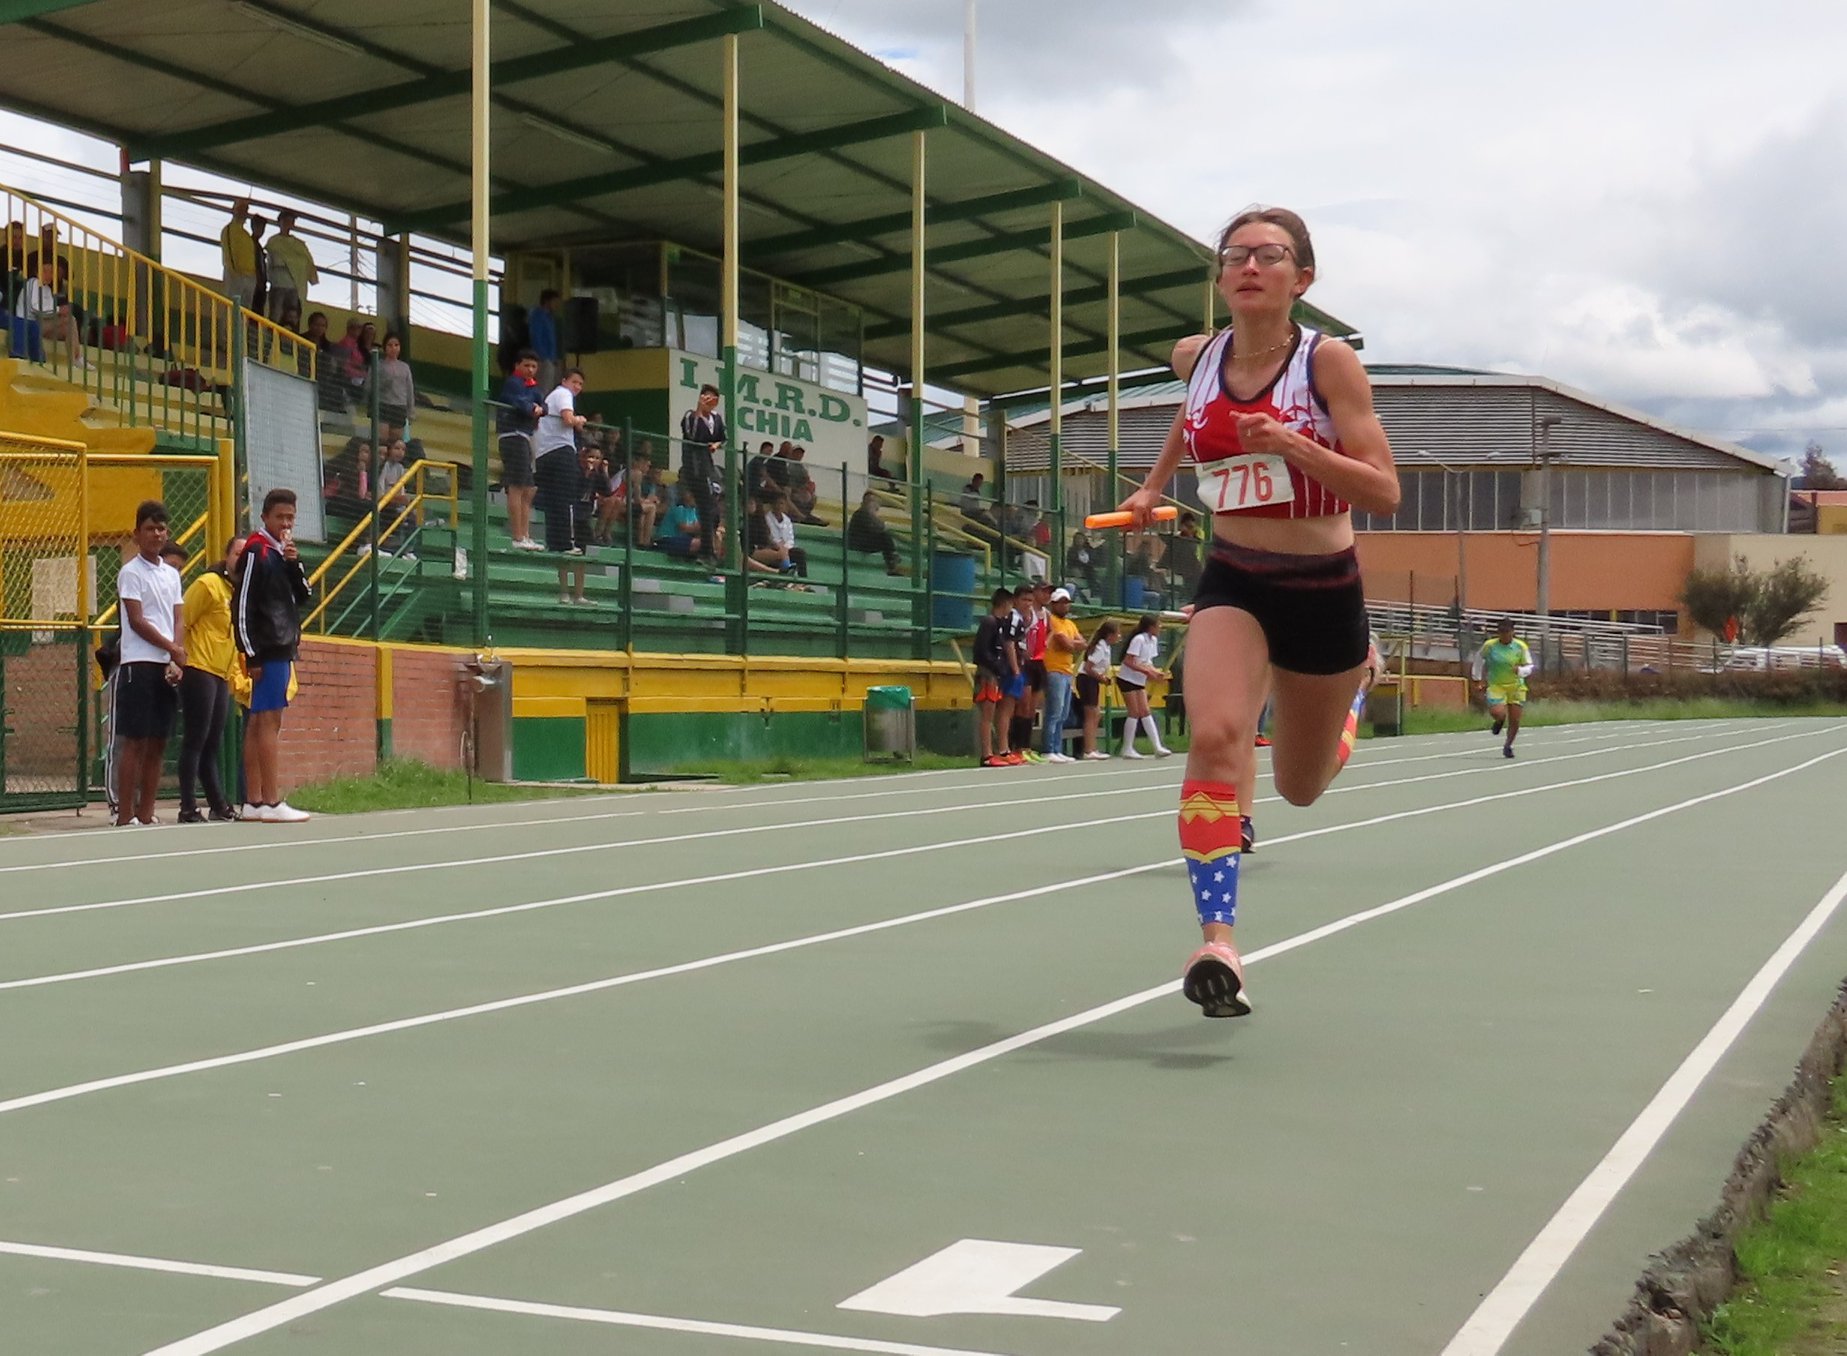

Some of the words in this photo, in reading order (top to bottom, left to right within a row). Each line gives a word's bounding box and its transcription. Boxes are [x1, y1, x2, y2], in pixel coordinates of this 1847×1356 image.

[679, 357, 862, 428] IM.R.D.
[738, 406, 814, 443] CHIA
[1211, 461, 1273, 509] 776
